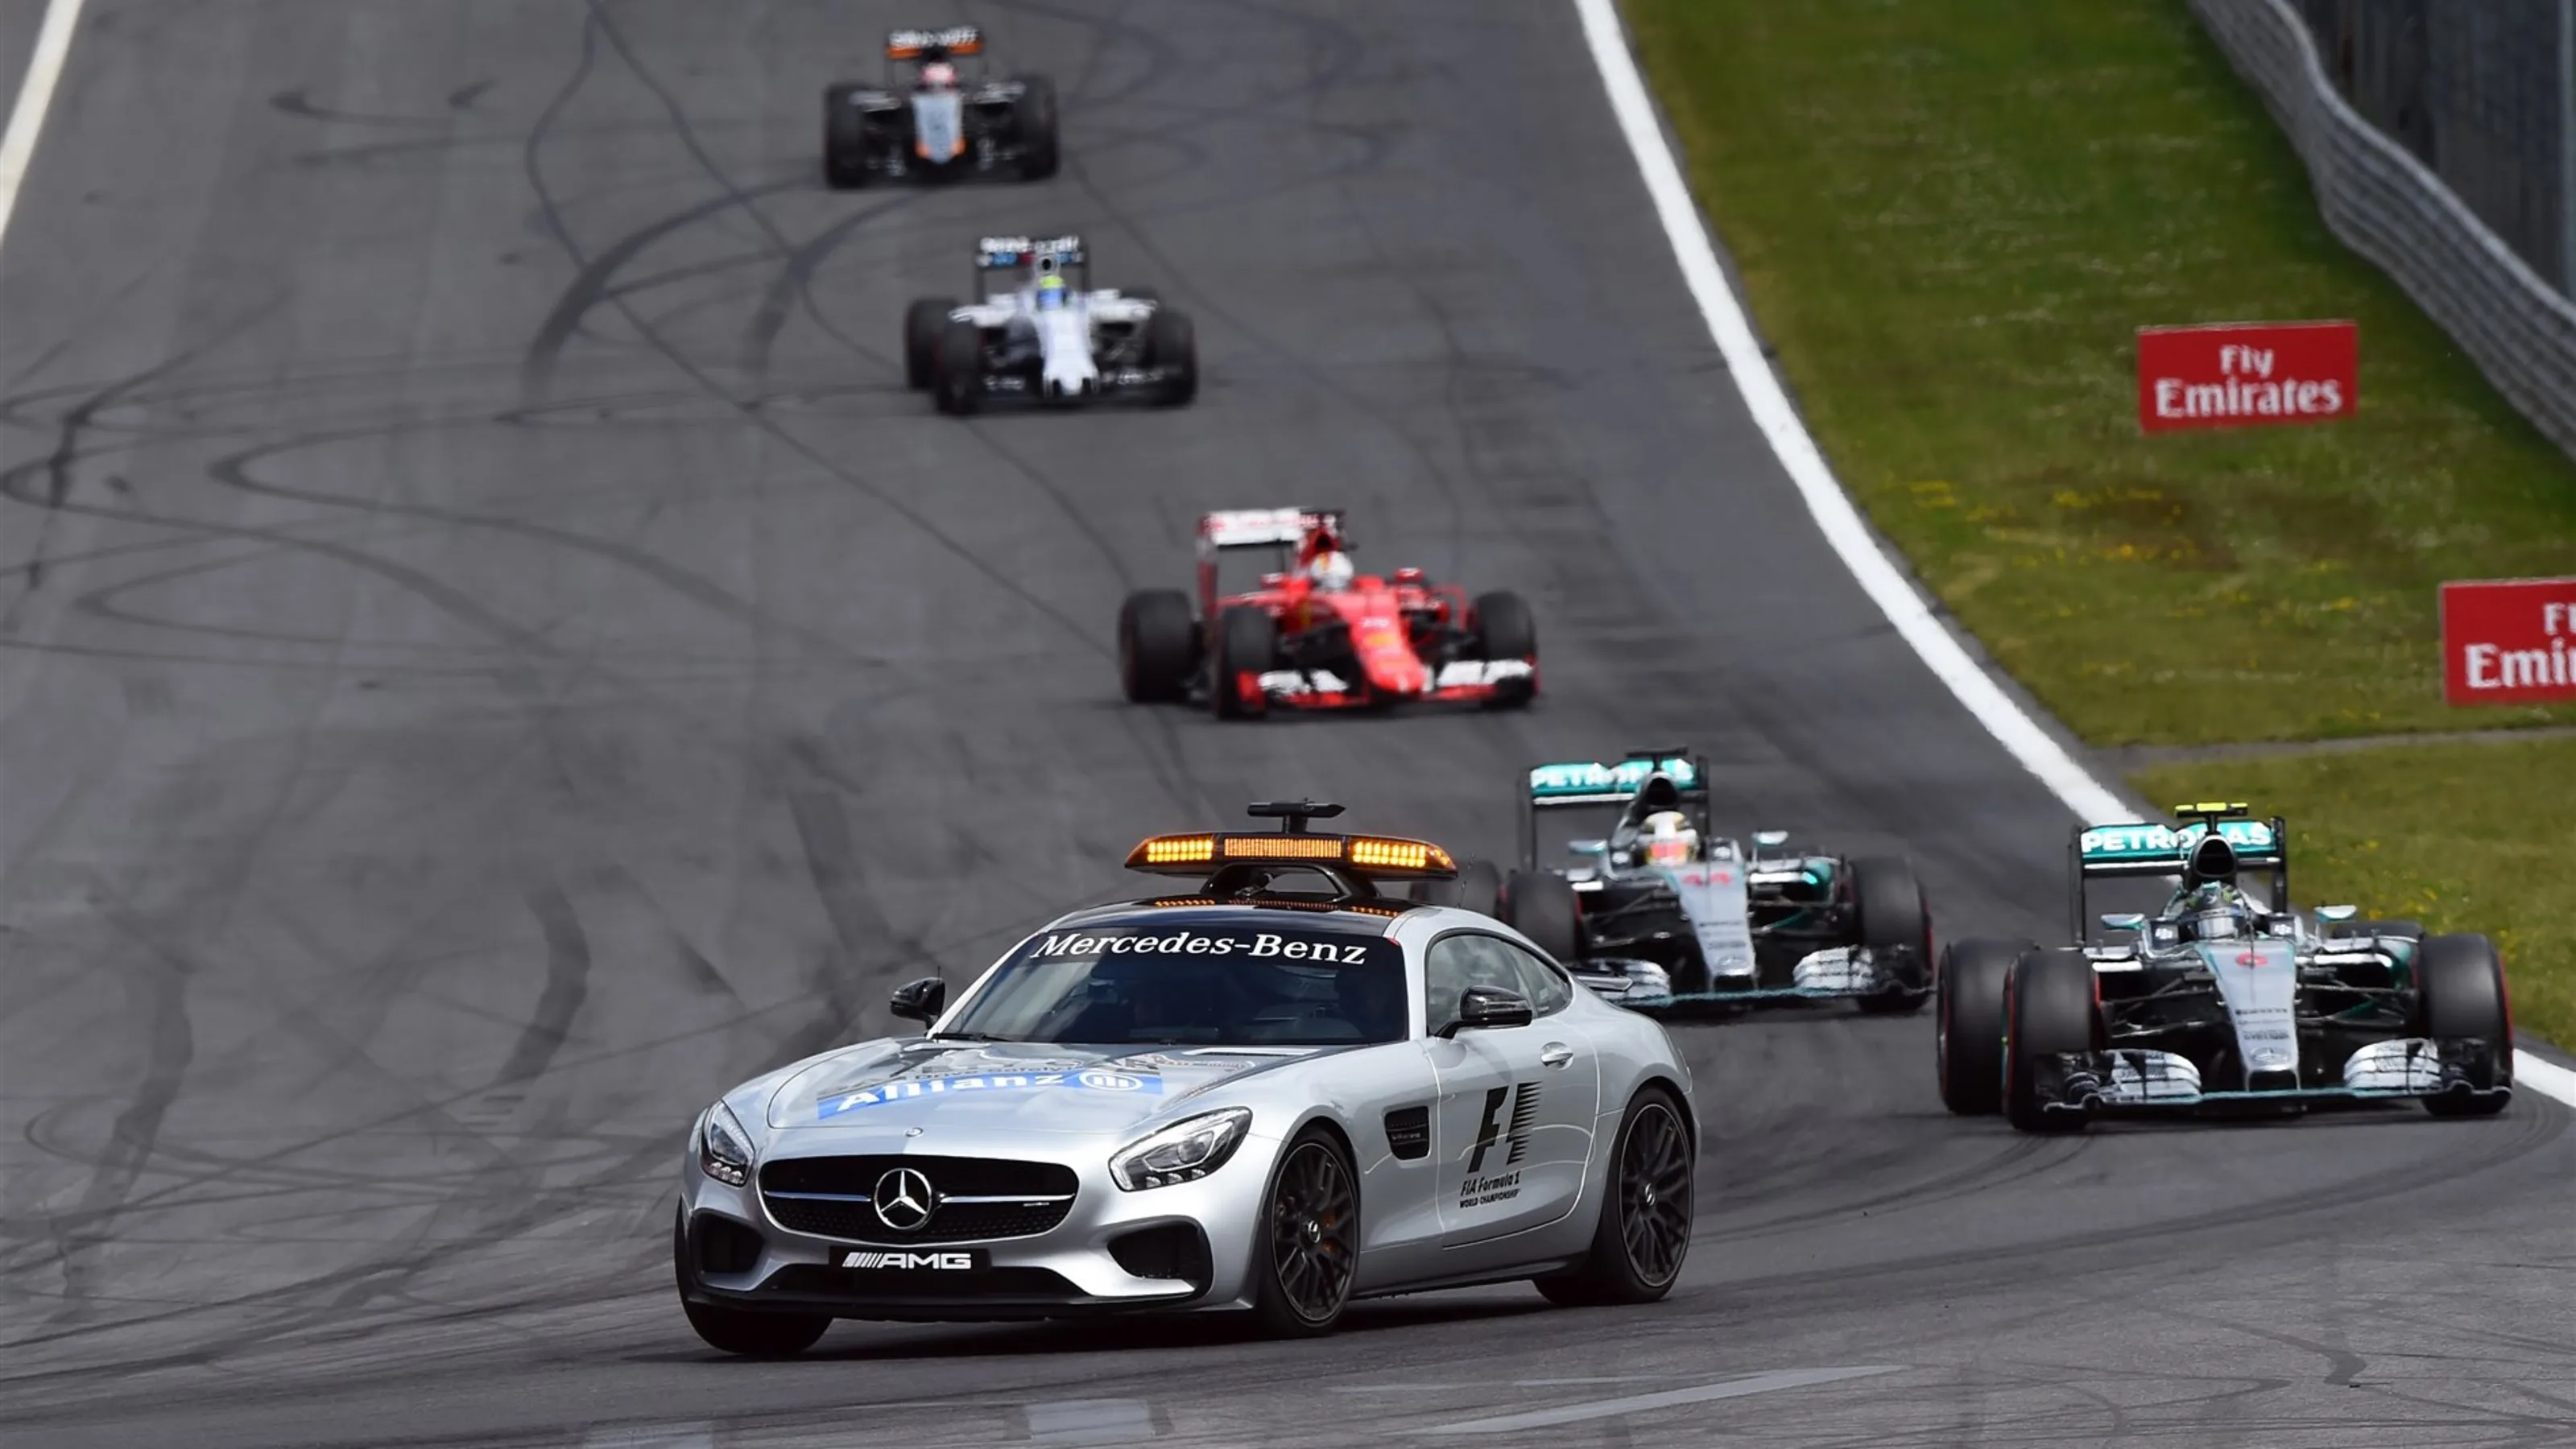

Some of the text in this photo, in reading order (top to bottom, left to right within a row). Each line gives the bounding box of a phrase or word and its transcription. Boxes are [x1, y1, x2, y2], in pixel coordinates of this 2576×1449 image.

[2219, 345, 2275, 378] Fly
[2155, 375, 2342, 418] Emirates
[2081, 821, 2272, 853] PETROAS
[1029, 931, 1368, 965] Mercedes-Benz
[837, 1074, 1065, 1112] Allianz
[1460, 1179, 1477, 1197] FIA
[877, 1253, 971, 1269] AMG
